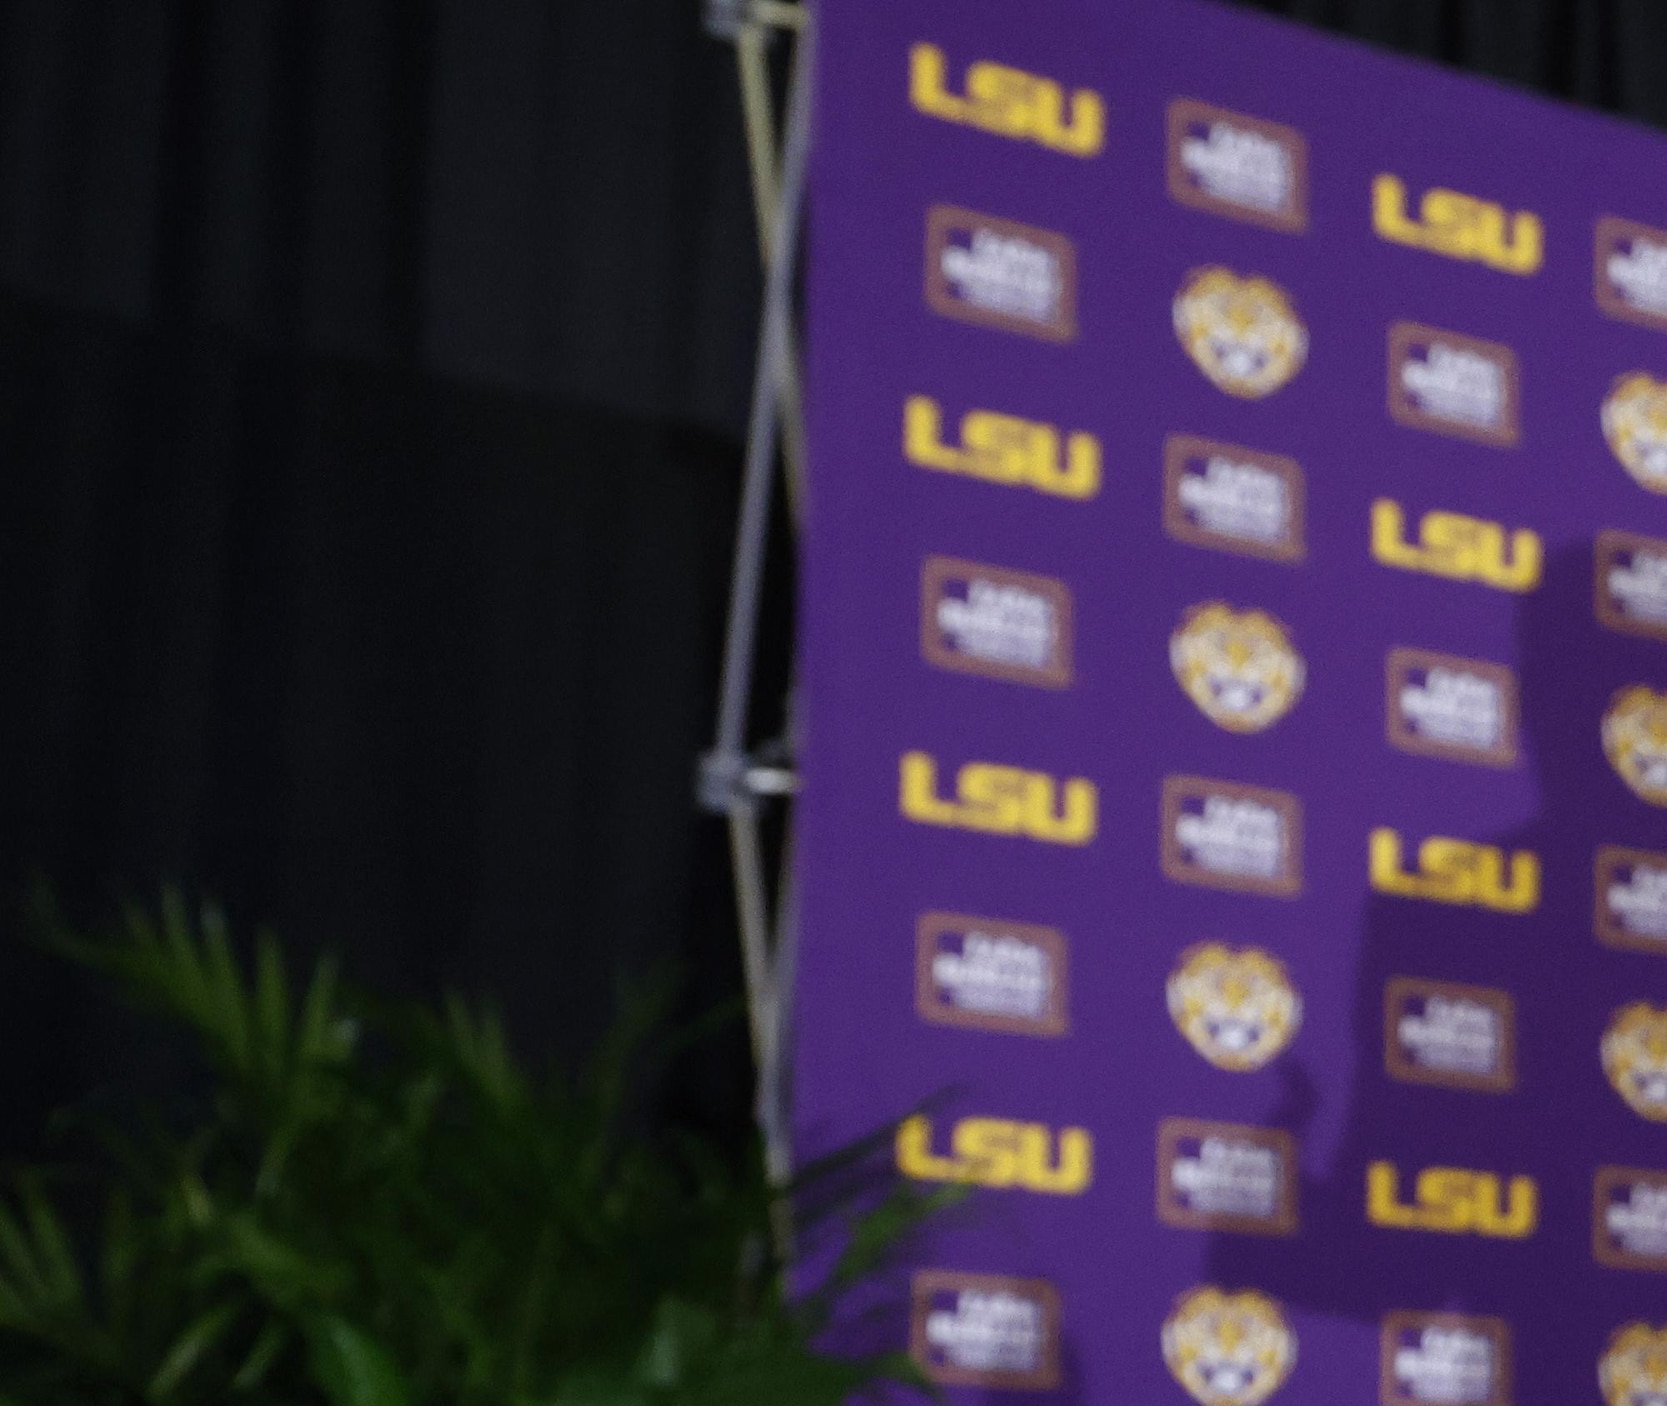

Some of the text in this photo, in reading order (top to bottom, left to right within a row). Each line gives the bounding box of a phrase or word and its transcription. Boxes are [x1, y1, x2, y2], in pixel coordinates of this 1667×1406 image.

[912, 46, 1102, 156] LSU
[1375, 175, 1541, 273] LSU
[906, 398, 1099, 498] LSU
[1373, 501, 1541, 590] LSU
[901, 753, 1095, 843] LSU
[1371, 829, 1539, 912] LSU
[895, 1115, 1091, 1194] LSU
[1368, 1162, 1536, 1237] LSU
